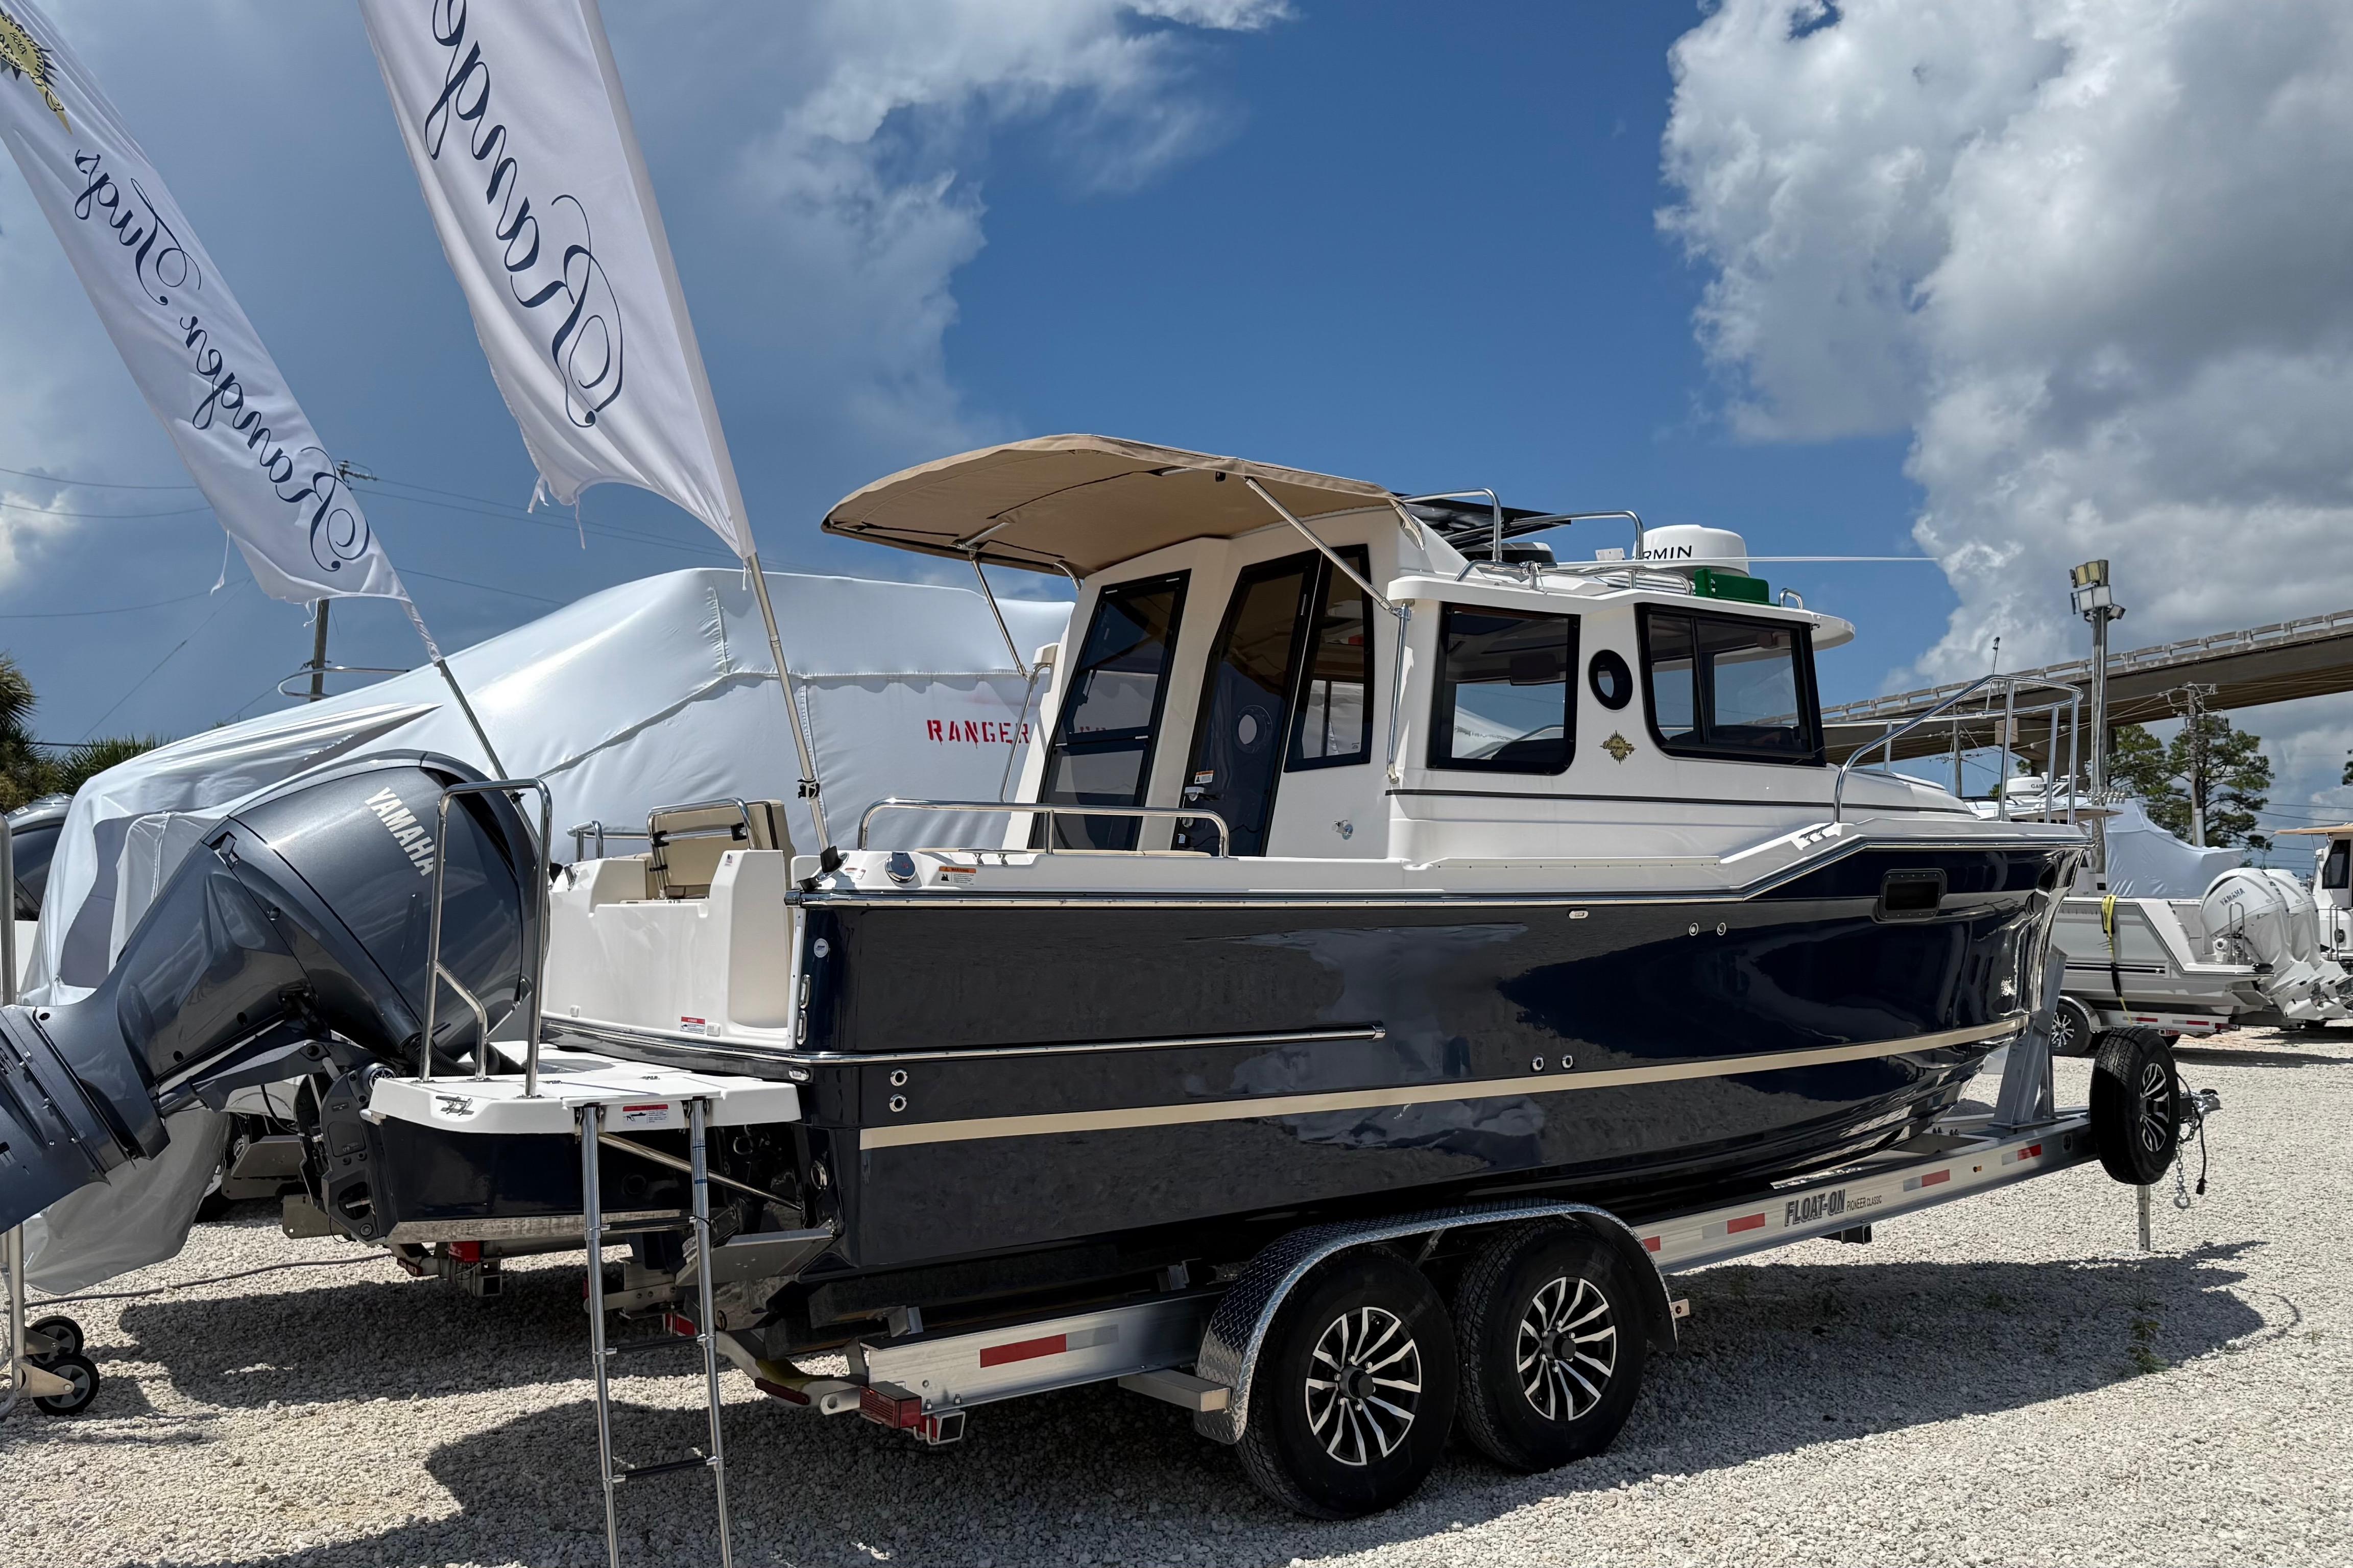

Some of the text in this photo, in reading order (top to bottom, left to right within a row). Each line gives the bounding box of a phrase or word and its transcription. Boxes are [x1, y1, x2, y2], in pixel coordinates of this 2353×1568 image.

[1643, 545, 1692, 560] RMIN
[927, 719, 1029, 745] RANGER
[365, 787, 435, 876] YAMAHA
[2219, 888, 2245, 906] YAMAHA
[1785, 1189, 1845, 1226] FLOAT-ON
[1846, 1197, 1866, 1211] PIONEER
